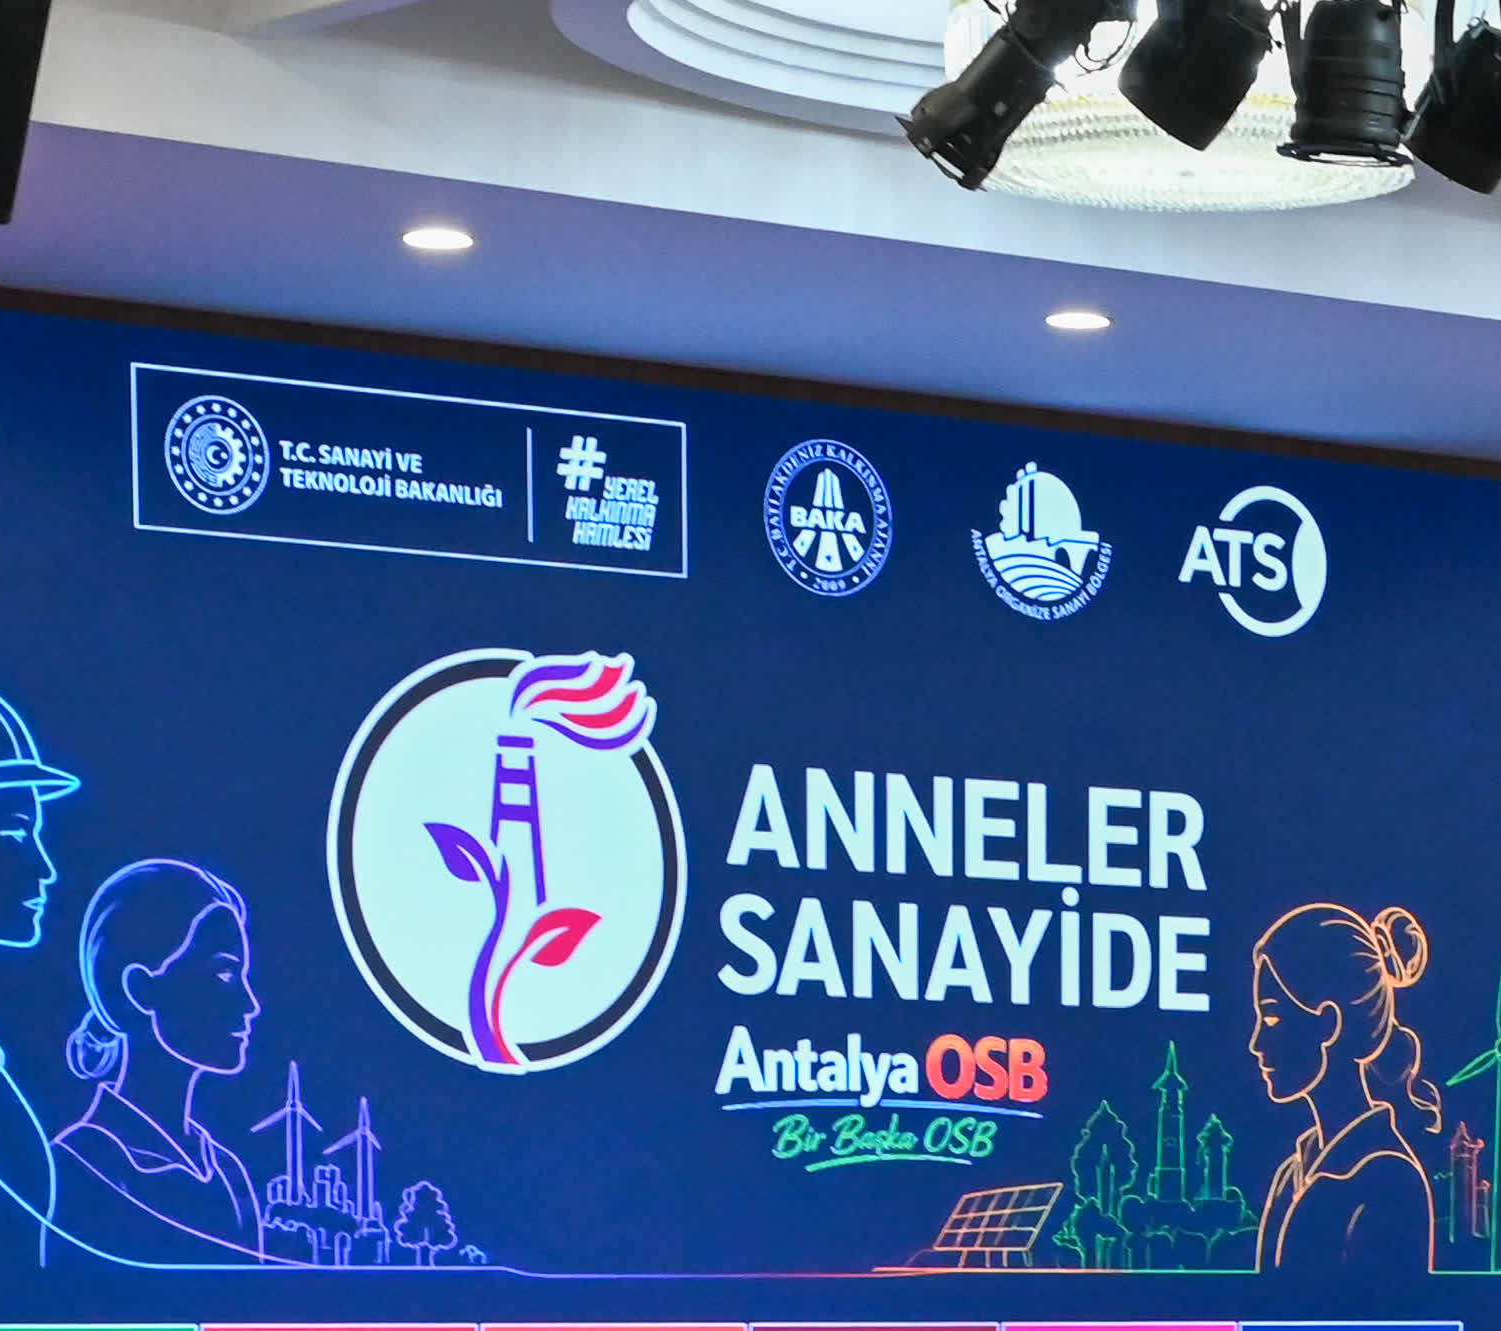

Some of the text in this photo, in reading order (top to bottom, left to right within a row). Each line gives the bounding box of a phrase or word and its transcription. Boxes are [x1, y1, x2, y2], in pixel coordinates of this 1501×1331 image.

[279, 440, 423, 474] T.C. SANAYİ VE
[279, 467, 503, 509] TEKNOLOJİ BAKANLIĞI
[790, 505, 866, 534] BAKA
[726, 763, 1208, 891] ANNELER
[717, 886, 1210, 1012] SANAYİDE
[715, 1024, 1049, 1107] Antalya OSB
[771, 1113, 827, 1159] Bir
[923, 1116, 998, 1158] OSB
